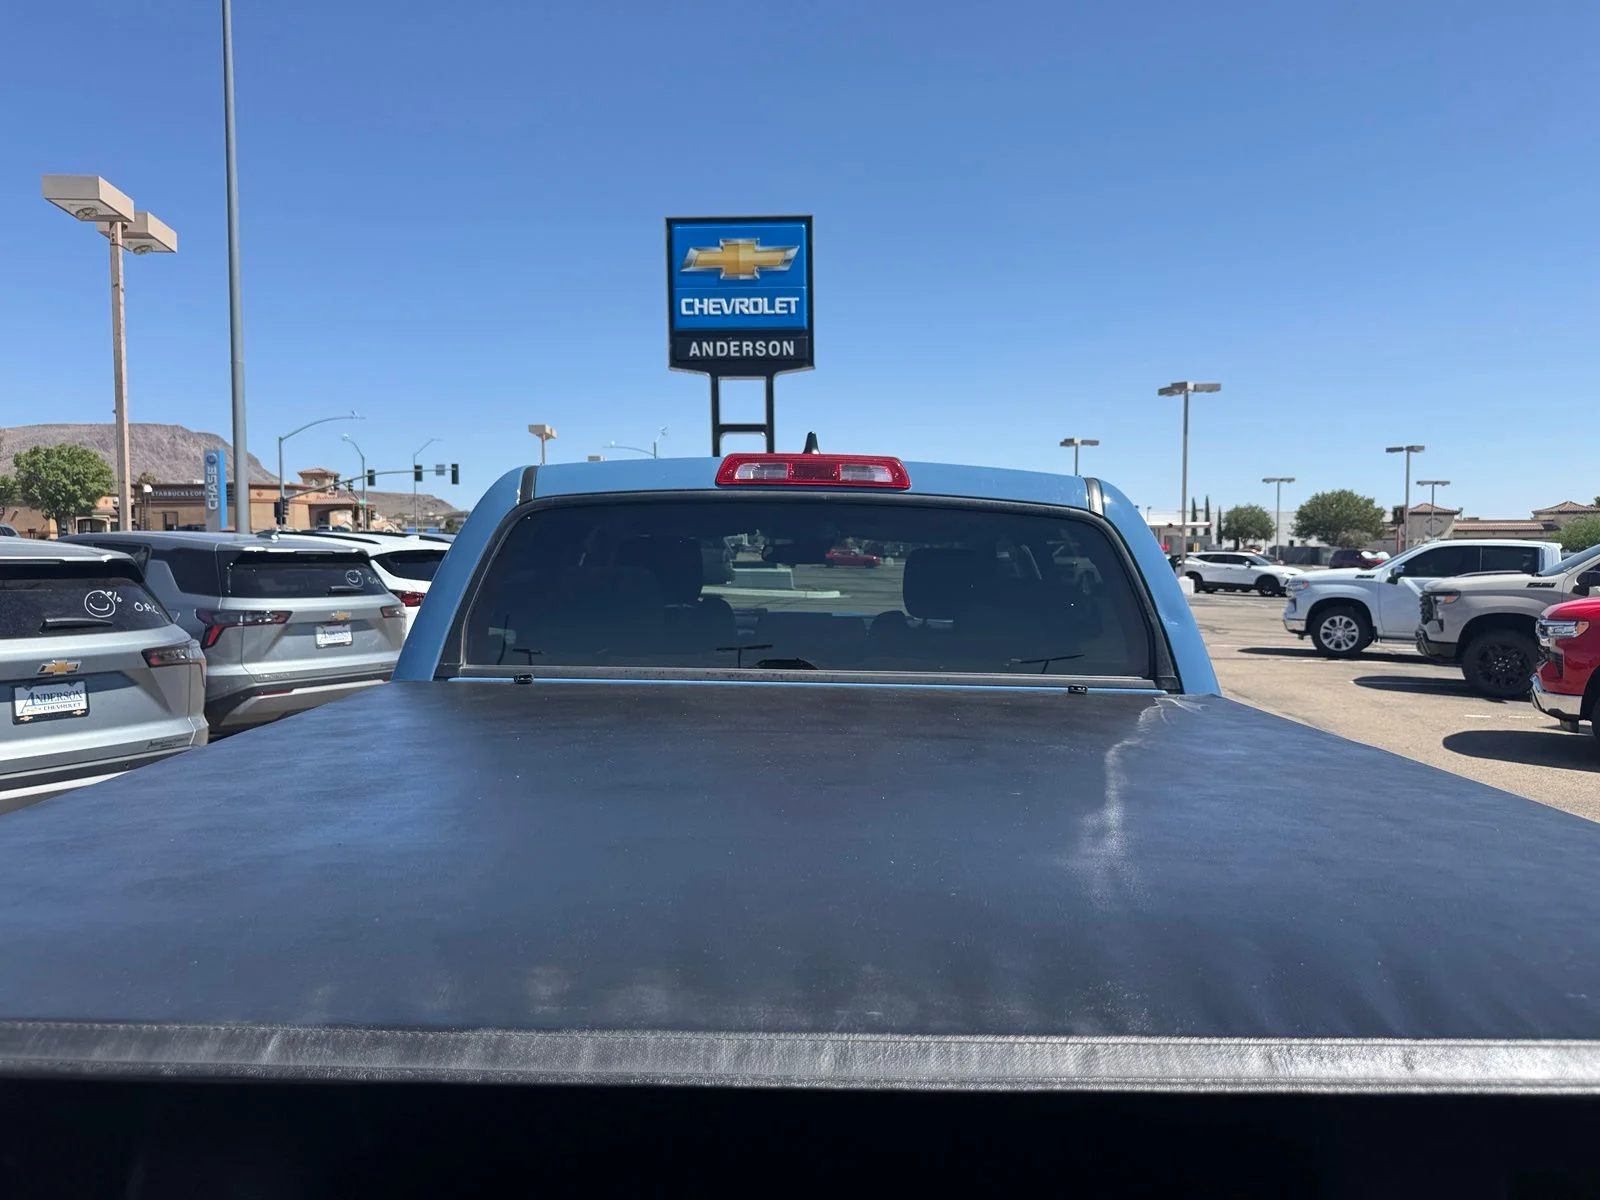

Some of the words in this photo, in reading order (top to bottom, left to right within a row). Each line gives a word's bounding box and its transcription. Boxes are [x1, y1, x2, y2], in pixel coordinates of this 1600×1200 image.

[680, 297, 800, 315] CHEVROLET
[689, 340, 795, 357] ANDERSON
[208, 466, 218, 510] CHASE
[19, 690, 83, 714] ANDERSON
